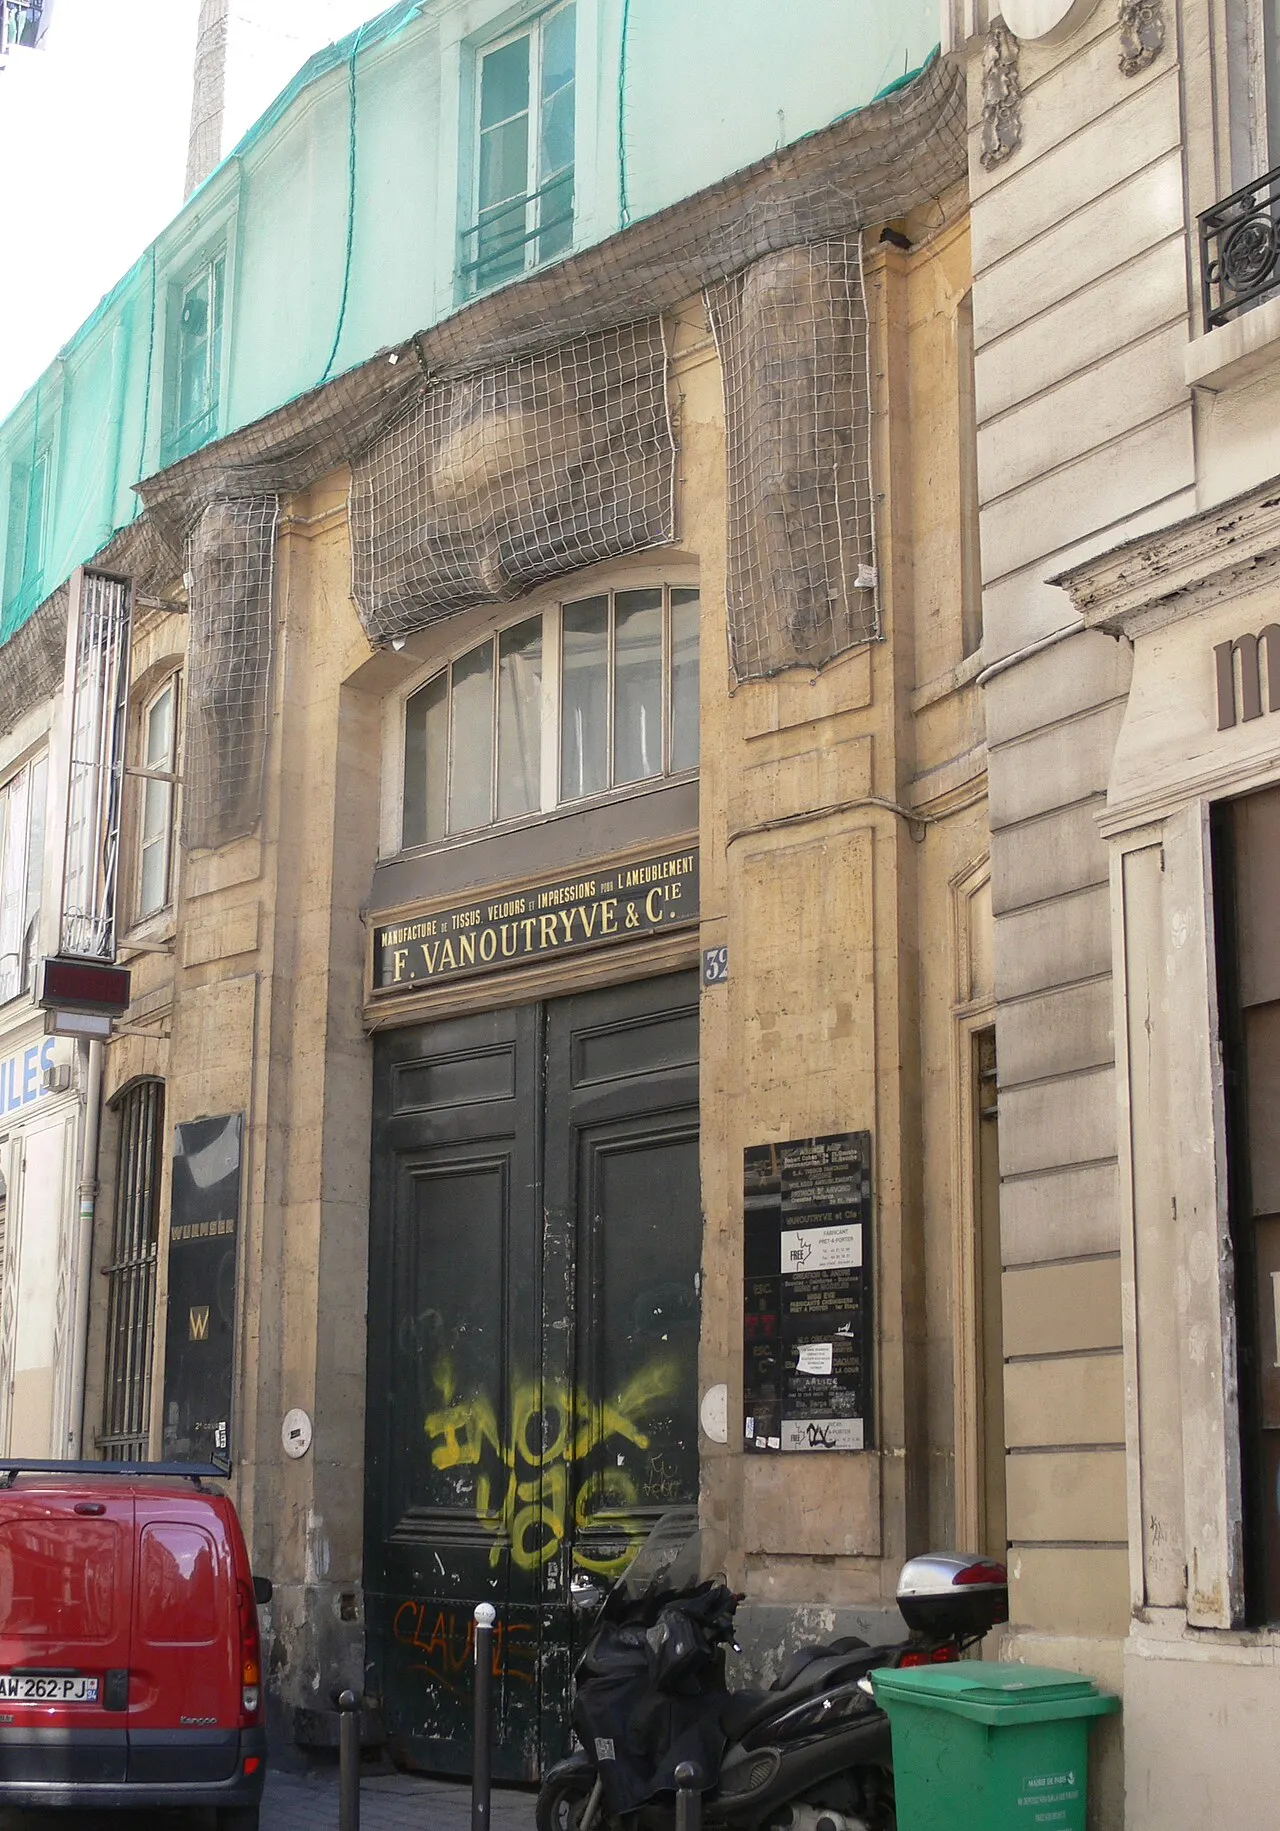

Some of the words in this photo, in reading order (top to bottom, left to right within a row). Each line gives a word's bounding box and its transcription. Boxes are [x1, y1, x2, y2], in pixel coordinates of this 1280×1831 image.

[381, 921, 437, 948] MANUFACTURE
[488, 899, 525, 921] VELOURS
[537, 881, 596, 909] IMPRESSIONS
[393, 948, 415, 982] F.
[421, 898, 618, 974] VANOUTRYVE
[625, 902, 640, 929] &
[790, 1249, 804, 1261] FREE
[189, 1306, 210, 1340] W
